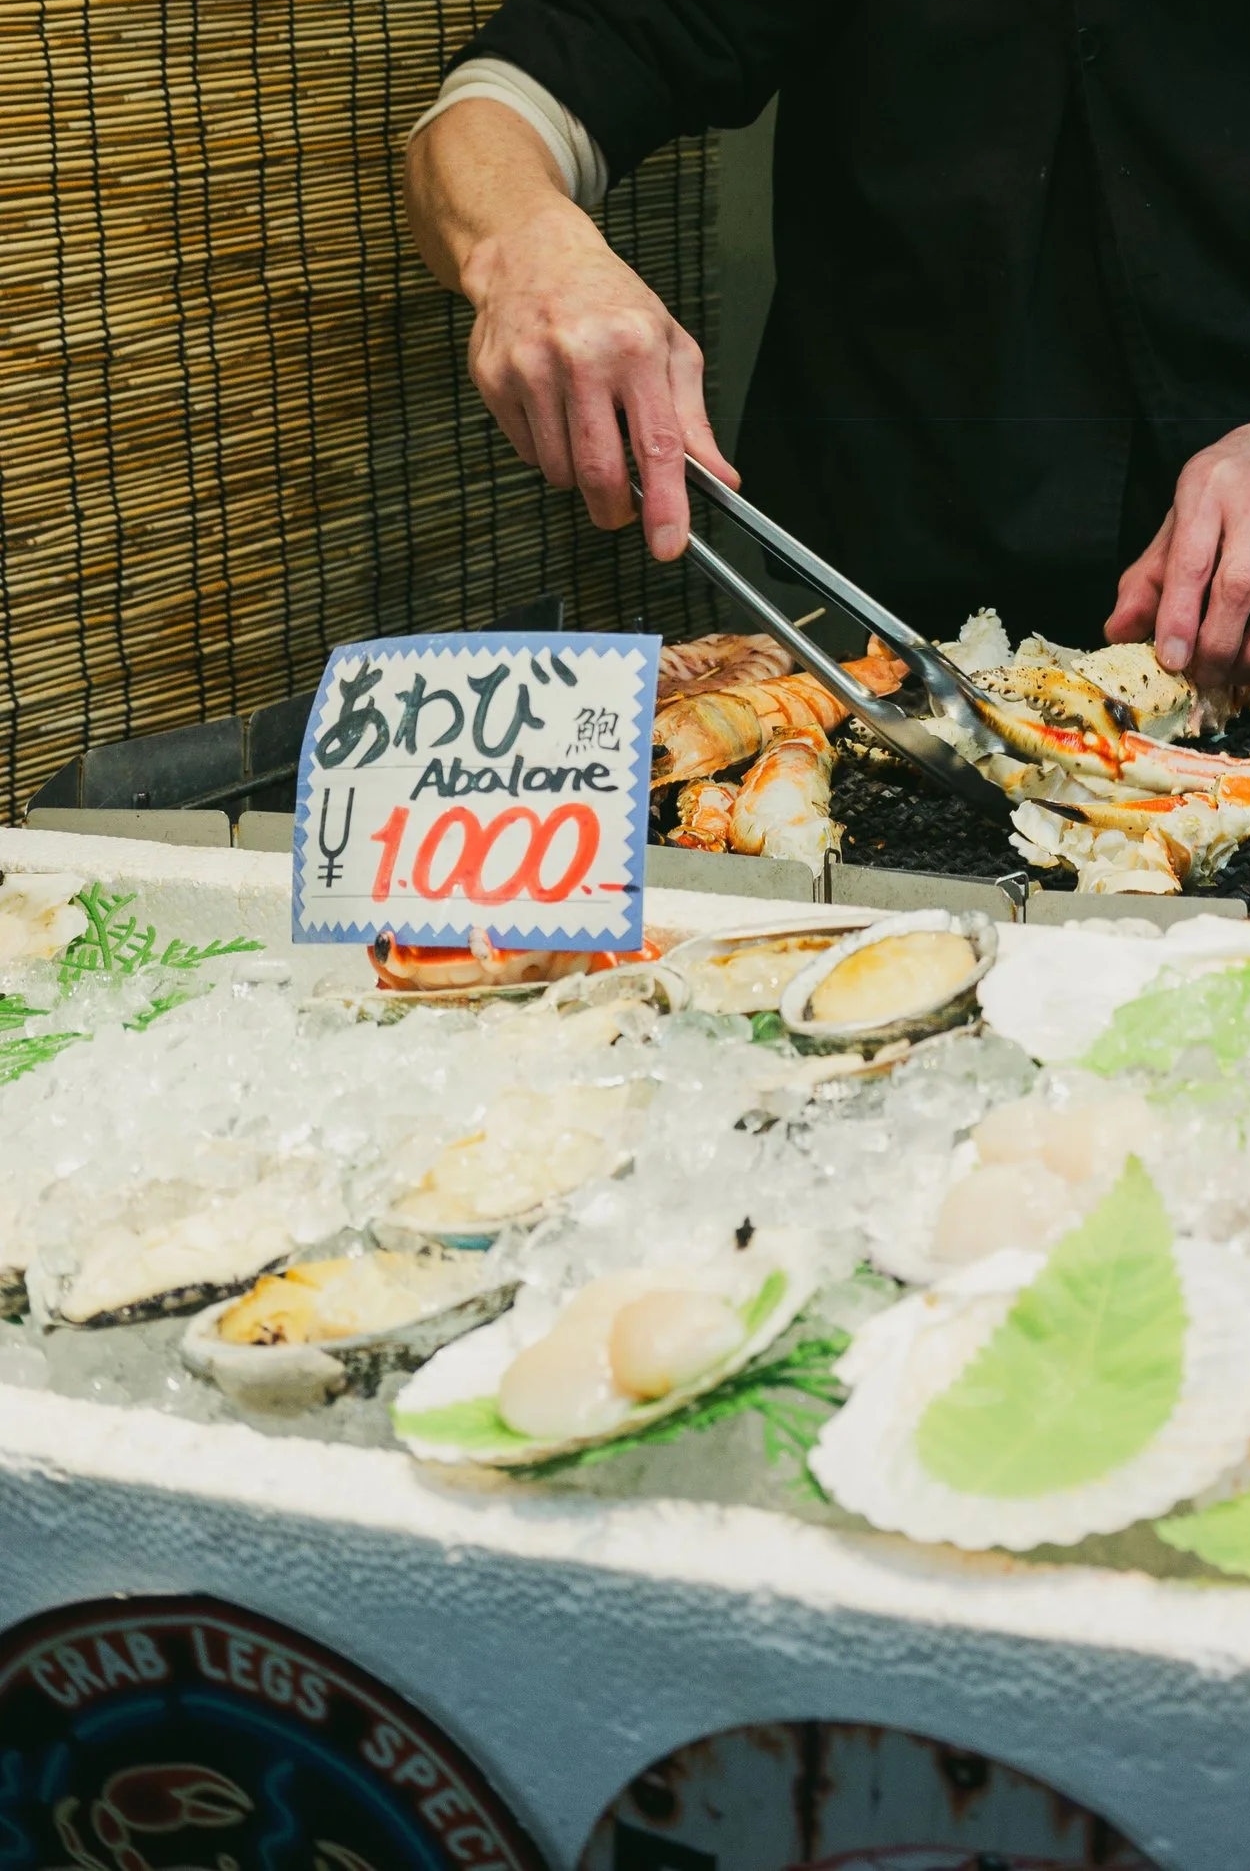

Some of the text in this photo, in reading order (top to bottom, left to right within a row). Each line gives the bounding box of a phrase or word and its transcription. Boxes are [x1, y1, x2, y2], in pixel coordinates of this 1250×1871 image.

[314, 657, 621, 769] あわび 鮑
[409, 755, 619, 801] Abalone
[27, 1630, 169, 1706] CRAB
[192, 1626, 328, 1720] LEGS
